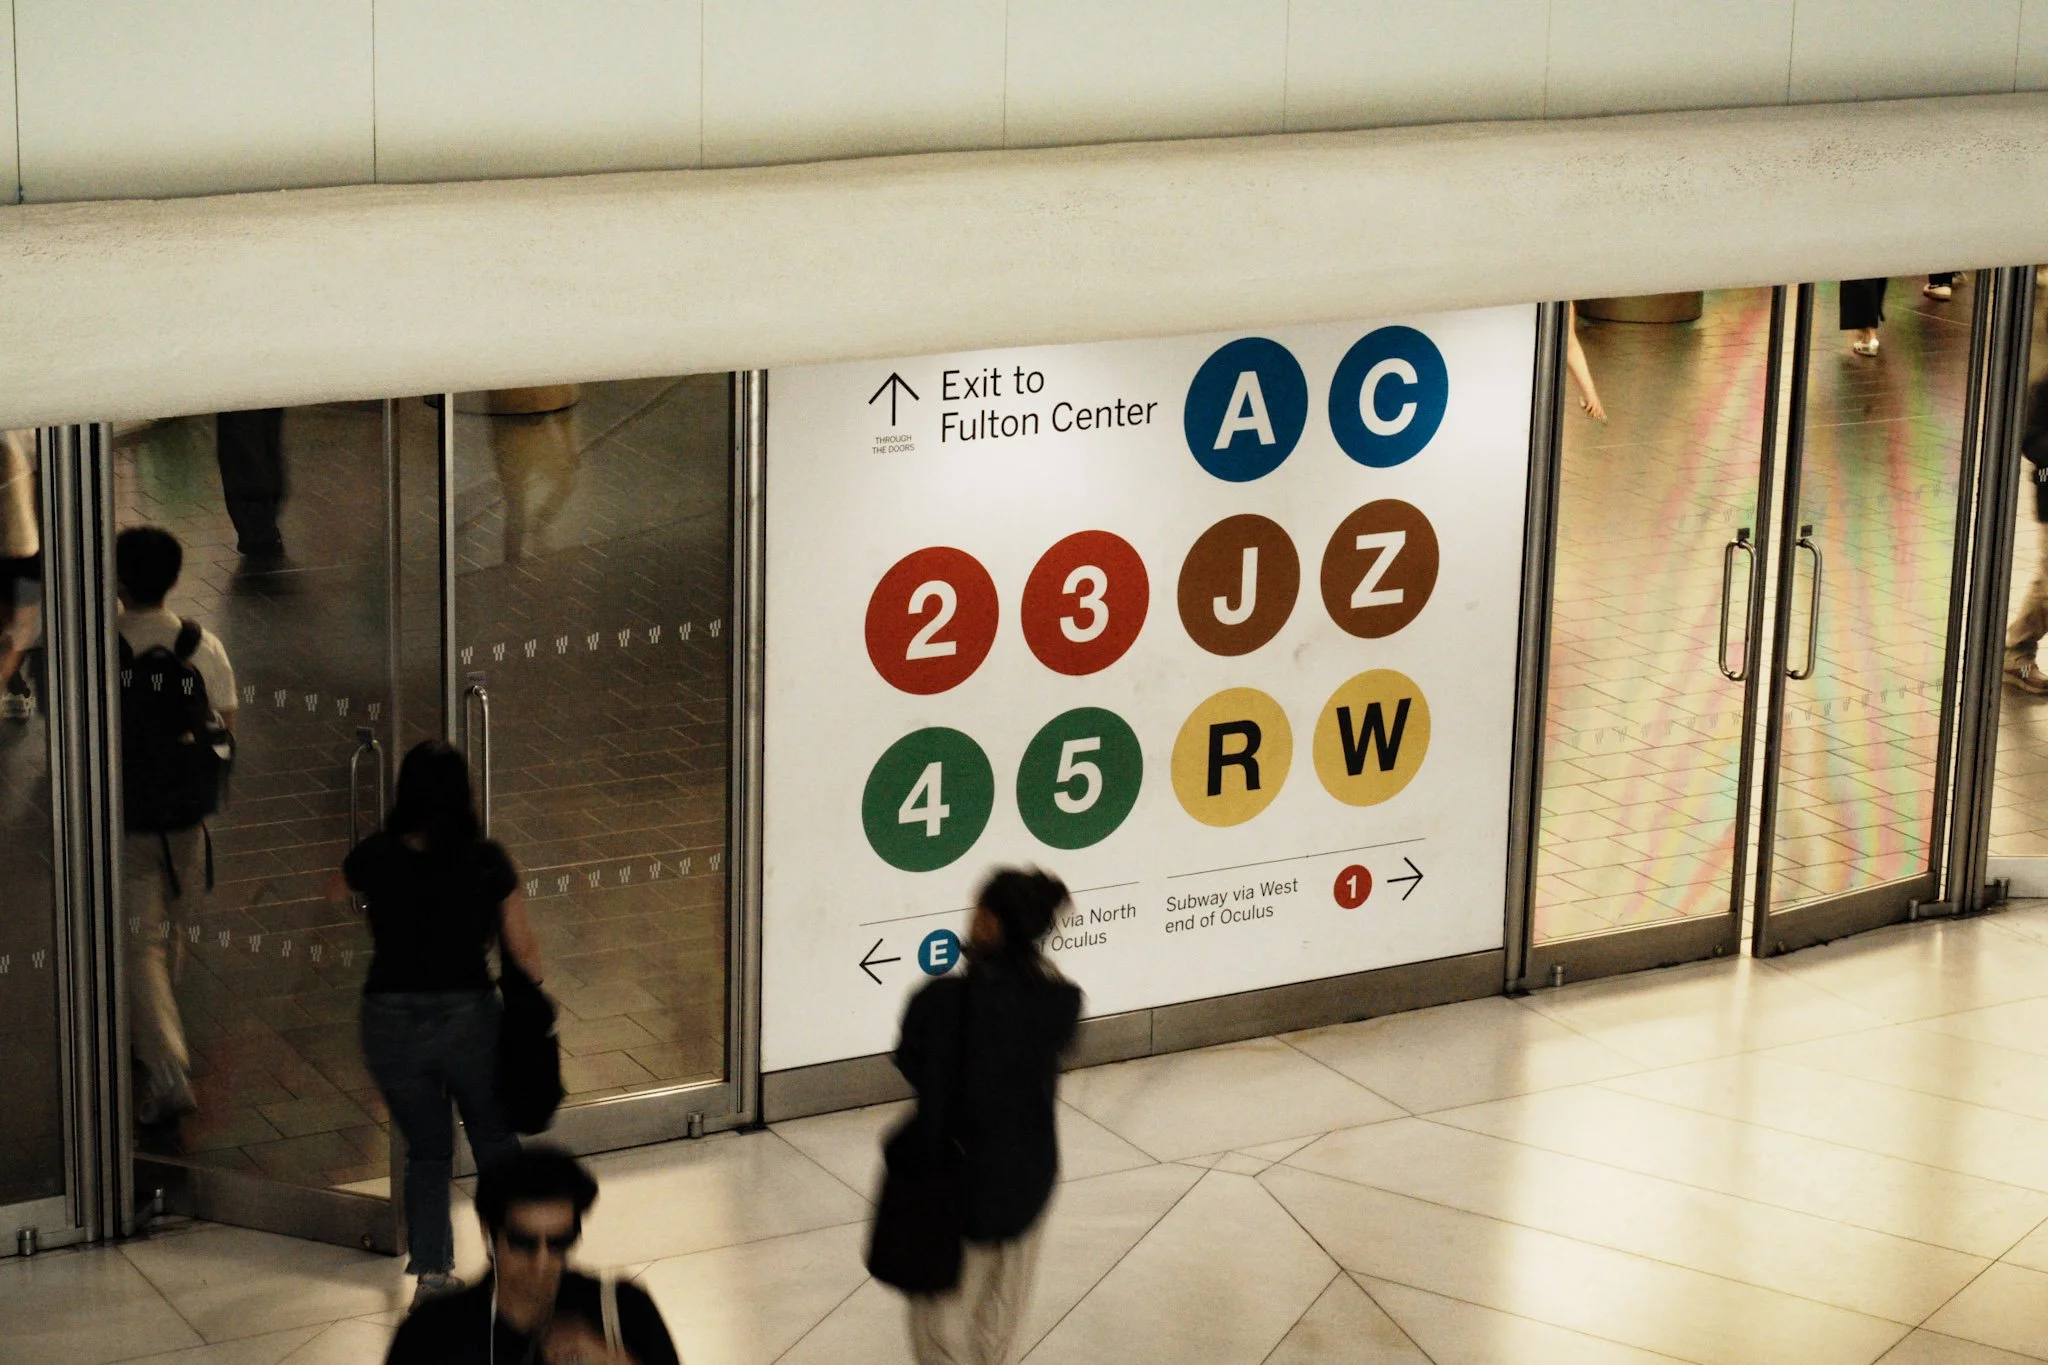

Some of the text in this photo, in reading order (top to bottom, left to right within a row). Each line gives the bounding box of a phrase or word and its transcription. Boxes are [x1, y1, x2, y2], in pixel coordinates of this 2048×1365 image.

[941, 366, 1045, 400] Exit to
[1213, 357, 1419, 450] A C
[941, 398, 1158, 443] Fulton Center
[871, 443, 915, 454] THE DOORS
[875, 434, 912, 444] THROUGH
[905, 530, 1407, 661] 2 3 J Z
[898, 697, 1412, 838] 4 5 R W
[1166, 877, 1298, 912] Subway via West
[1346, 874, 1358, 899] 1
[1061, 912, 1084, 929] via
[1089, 903, 1136, 925] North
[1164, 904, 1274, 934] end of Oculus
[929, 938, 949, 967] E
[1051, 931, 1107, 952] Oculus
